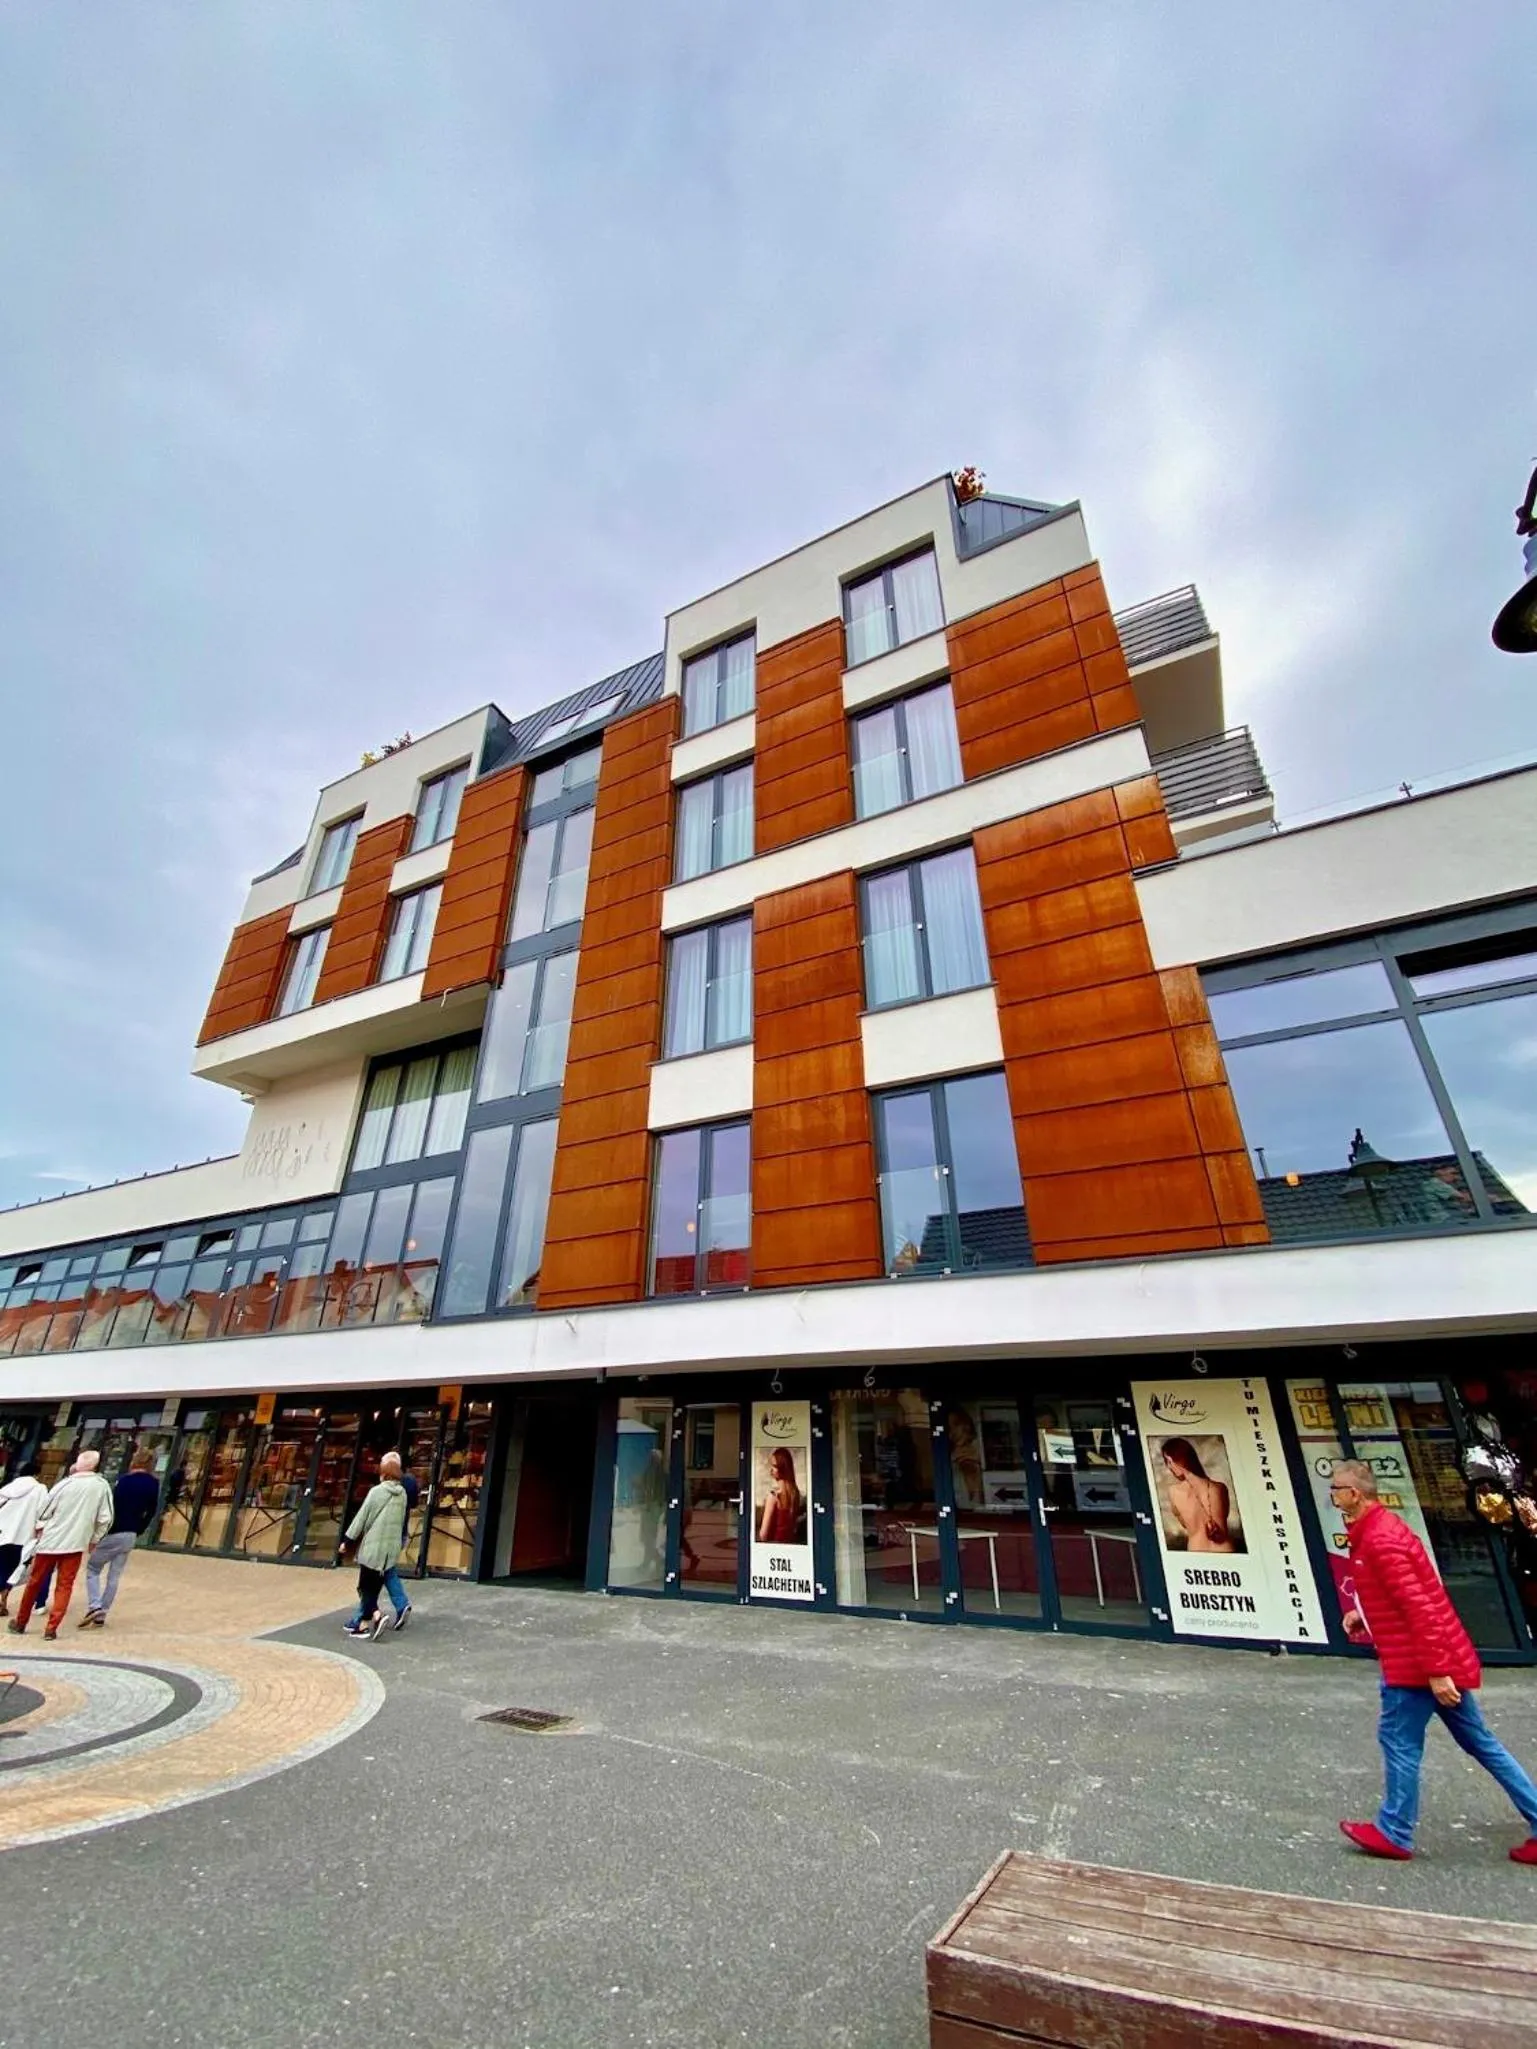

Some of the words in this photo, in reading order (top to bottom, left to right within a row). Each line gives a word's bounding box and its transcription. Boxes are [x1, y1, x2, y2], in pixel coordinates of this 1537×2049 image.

[1241, 1379, 1254, 1400] TU
[1164, 1393, 1195, 1416] Virgo
[1299, 1404, 1390, 1429] LENI
[1246, 1406, 1276, 1491] MIESZKA
[769, 1557, 793, 1572] STAL
[1272, 1500, 1310, 1637] INSPIRACJA
[752, 1575, 811, 1594] SZLACHETNA
[1184, 1569, 1242, 1588] SREBRO
[1180, 1592, 1257, 1613] BURSZTYN
